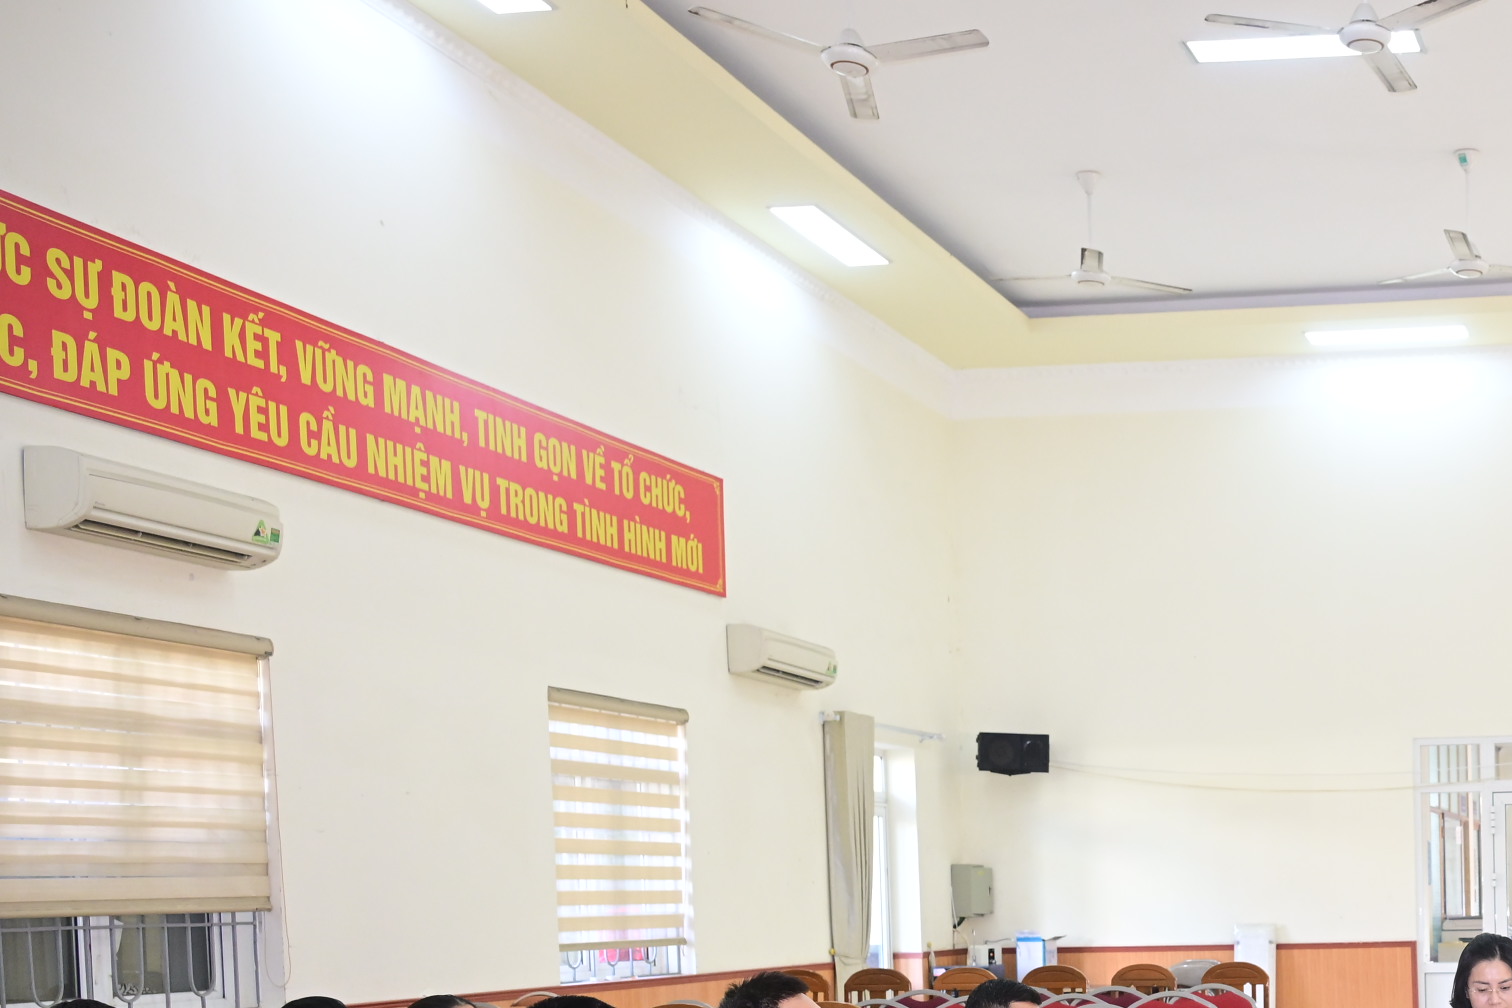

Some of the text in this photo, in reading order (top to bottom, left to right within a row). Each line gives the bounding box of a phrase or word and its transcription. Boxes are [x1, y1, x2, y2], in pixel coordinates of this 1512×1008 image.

[46, 247, 103, 321] SỰ
[111, 269, 213, 352] ĐOÀN
[222, 311, 287, 382] KẾT,
[295, 339, 375, 408] VỮNG
[383, 373, 468, 446] MẠNH,
[475, 408, 527, 462] TINH
[534, 432, 576, 481] GỌN
[582, 445, 606, 490] VỀ
[611, 454, 635, 499] TỔ
[639, 470, 690, 523] CHỨC,
[51, 328, 131, 396] ĐÁP
[144, 352, 218, 427] ỨNG
[227, 386, 289, 447] YÊU
[299, 405, 357, 468] CẦU
[366, 433, 452, 499] NHIỆM
[459, 465, 491, 517] VỤ
[497, 477, 568, 534] TRONG
[574, 498, 619, 549] TÌNH
[624, 515, 666, 562] HÌNH
[671, 534, 704, 573] MỚI
